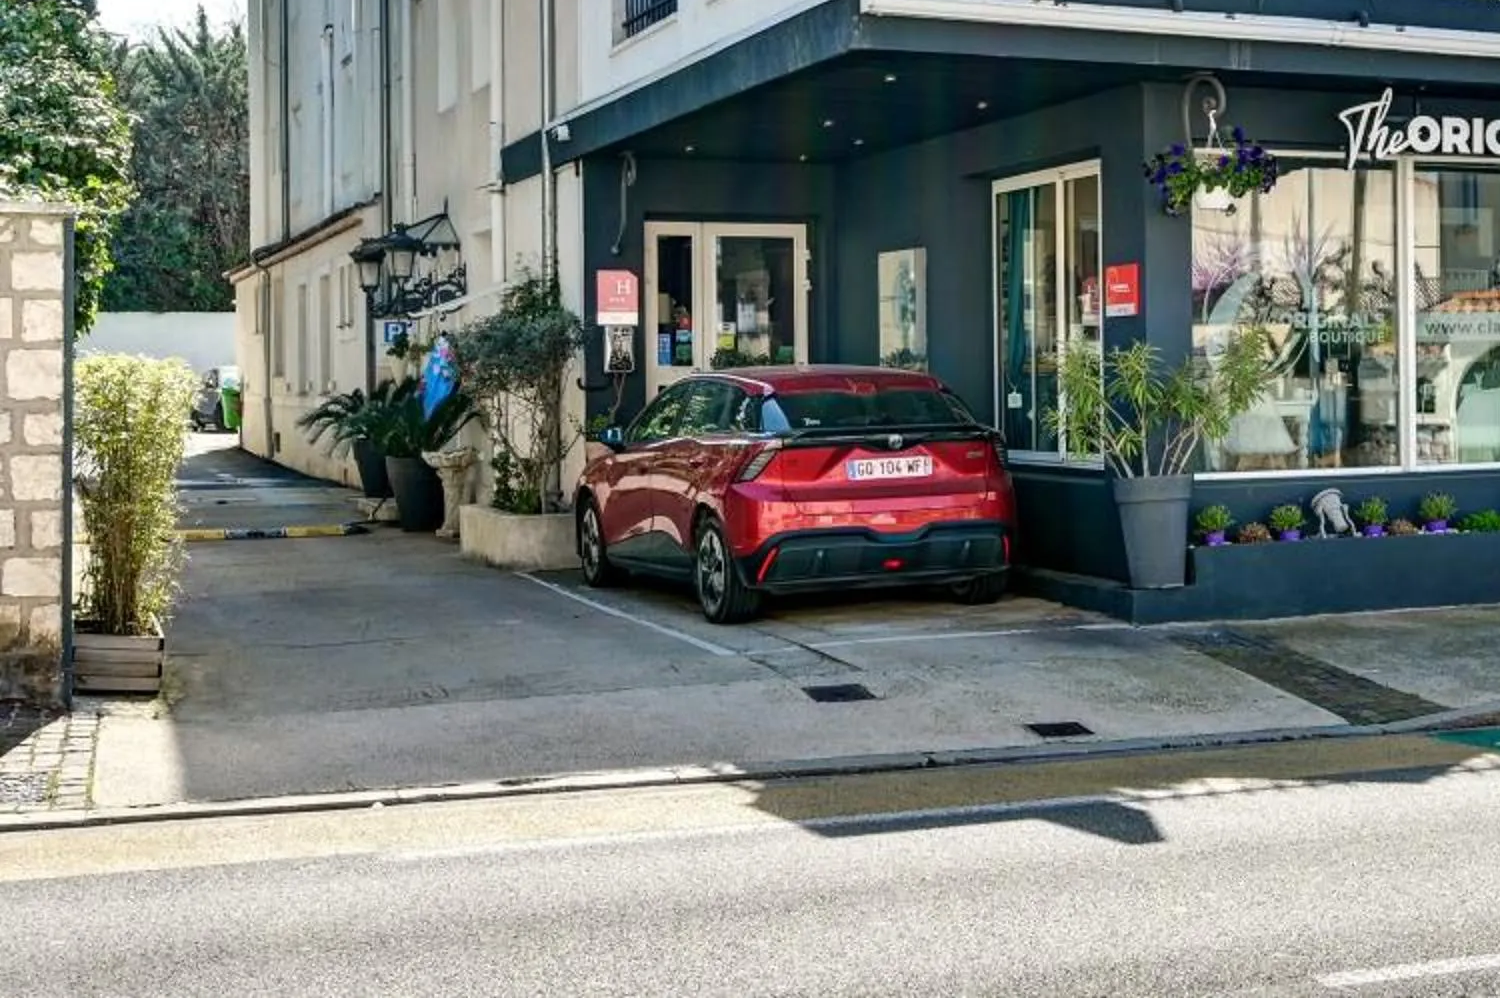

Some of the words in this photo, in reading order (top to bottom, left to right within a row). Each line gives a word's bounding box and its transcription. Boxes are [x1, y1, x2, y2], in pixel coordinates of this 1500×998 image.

[1339, 87, 1411, 171] The
[388, 323, 403, 341] P
[1309, 330, 1386, 343] BOUTIQUE
